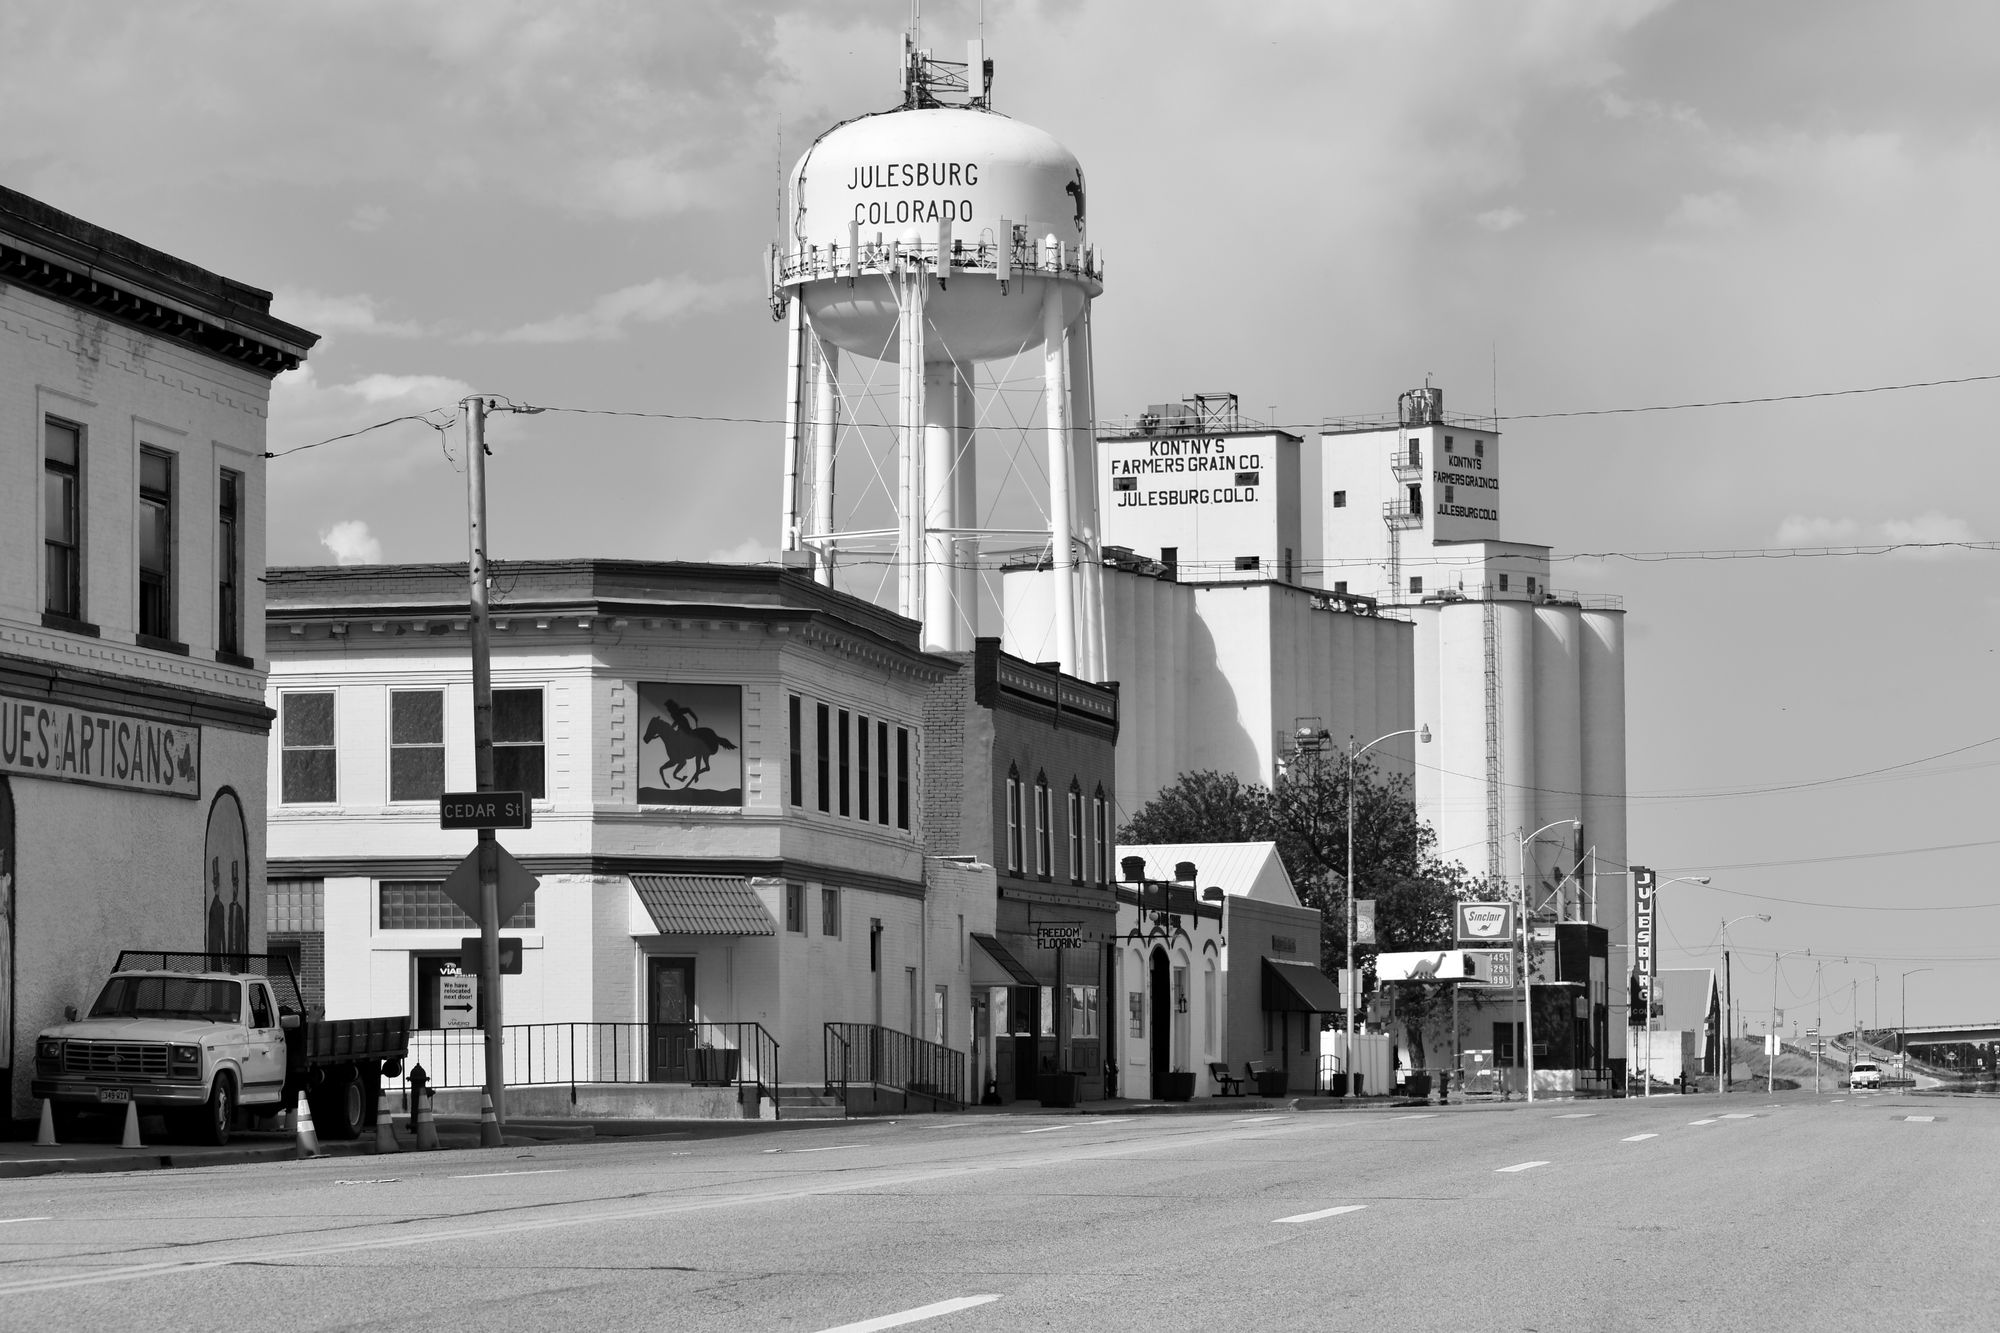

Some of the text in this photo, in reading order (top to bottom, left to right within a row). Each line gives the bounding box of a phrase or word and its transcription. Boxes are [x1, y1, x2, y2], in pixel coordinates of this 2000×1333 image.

[848, 163, 978, 190] JULESBURG
[854, 199, 974, 226] COLORADO
[1149, 437, 1225, 457] KONTNY'S
[1111, 454, 1264, 475] FARMERS GRAIN CO.
[1433, 471, 1465, 485] FARMERS
[1465, 475, 1488, 488] GRAIN
[1213, 487, 1259, 504] COLO.
[2, 701, 51, 769] UES
[62, 712, 175, 786] ARTISANS
[444, 802, 521, 818] CEDAR St
[1468, 910, 1502, 923] Sinclair
[1037, 927, 1080, 938] FREEDOM
[1636, 872, 1651, 1001] JULESBURG
[1037, 937, 1082, 950] FLOORING
